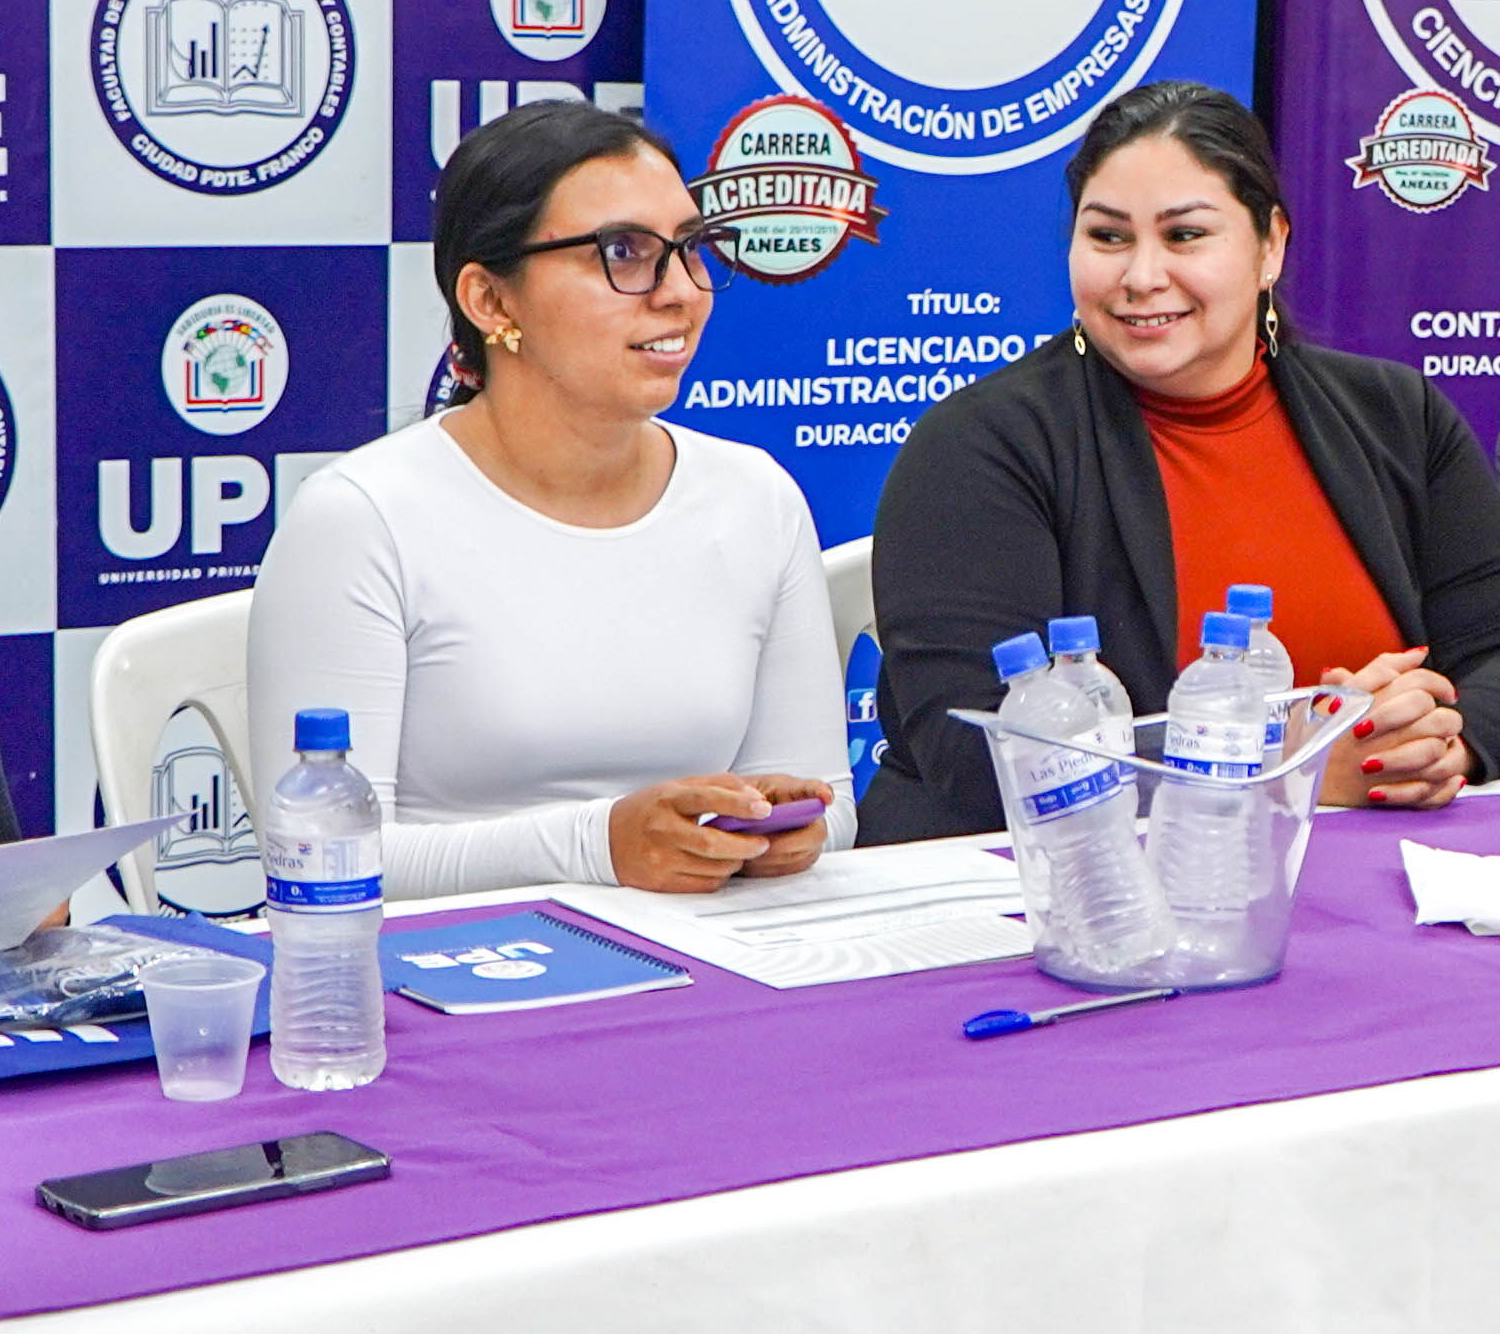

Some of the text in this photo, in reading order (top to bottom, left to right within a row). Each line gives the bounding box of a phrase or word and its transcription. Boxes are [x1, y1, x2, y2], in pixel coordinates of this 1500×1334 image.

[100, 29, 134, 125] FACULTAD
[317, 11, 345, 120] CONTABLES
[982, 107, 1024, 139] DE
[1400, 113, 1456, 129] CARRERA
[131, 125, 323, 187] CIUDAD PDTE. FRANCO
[741, 133, 831, 156] CARRERA
[1372, 140, 1478, 167] ACREDITADA
[702, 174, 866, 216] ACREDITADA
[745, 238, 822, 253] ANEAES
[907, 288, 1001, 315] TÍTULO:
[826, 335, 1026, 366] LICENCIADO
[796, 417, 913, 447] DURACIÓ
[99, 451, 350, 561] UP
[401, 941, 554, 969] UPE
